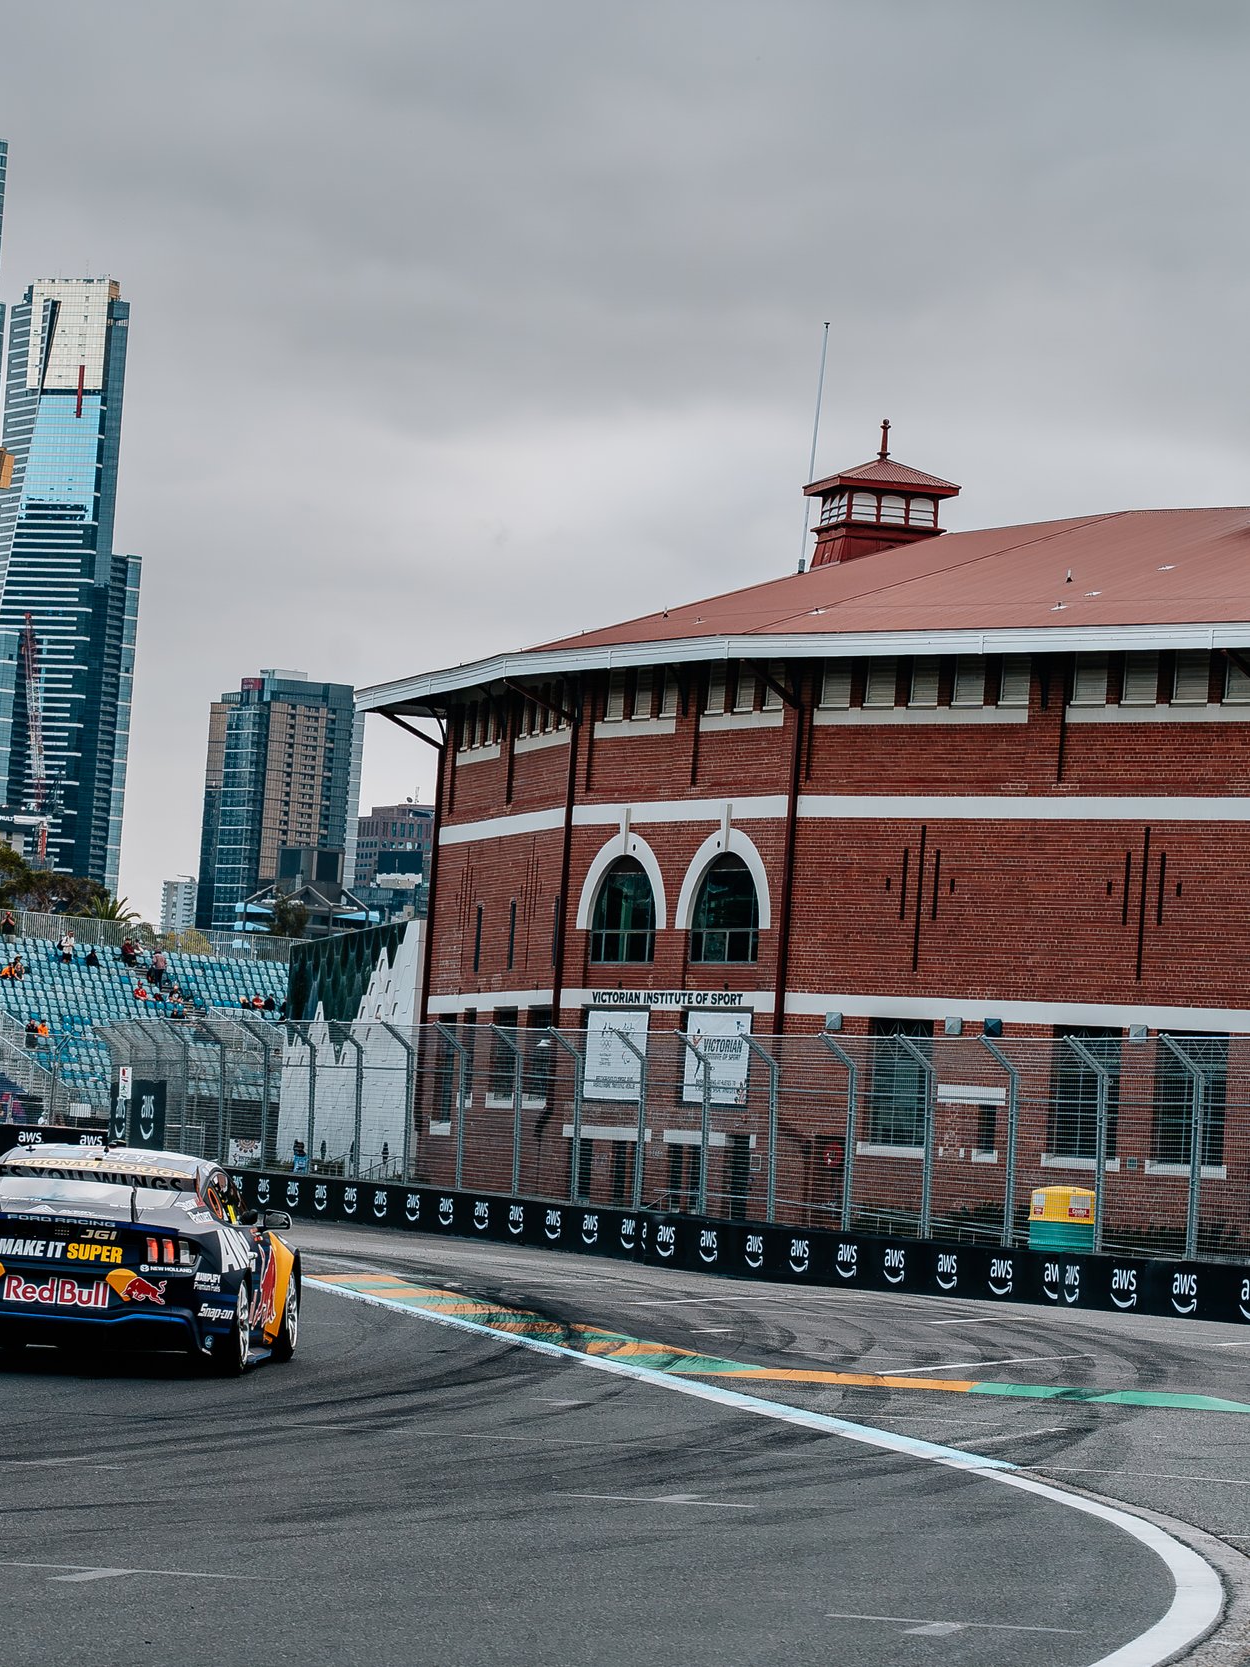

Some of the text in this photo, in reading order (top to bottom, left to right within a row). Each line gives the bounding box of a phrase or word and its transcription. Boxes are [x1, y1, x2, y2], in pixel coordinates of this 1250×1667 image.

[592, 991, 743, 1006] VICTORIAN INSTITUTE OF SPORT
[704, 1039, 743, 1053] VICTORIAN
[18, 1131, 42, 1144] aws
[79, 1134, 103, 1146] aws
[30, 1166, 85, 1181] YOU
[92, 1171, 184, 1192] WINGS
[258, 1179, 270, 1193] aws
[287, 1182, 299, 1196] aws
[315, 1185, 327, 1199] aws
[345, 1187, 357, 1202] aws
[374, 1191, 387, 1206] aws
[406, 1194, 420, 1210] aws
[440, 1198, 454, 1214] aws
[474, 1201, 489, 1218] aws
[509, 1205, 524, 1222] aws
[7, 1214, 52, 1223] FORD
[54, 1215, 116, 1228] RACING
[546, 1210, 561, 1227] aws
[583, 1214, 599, 1232] aws
[657, 1225, 675, 1243] aws
[700, 1230, 717, 1248] aws
[46, 1241, 66, 1258] IT
[67, 1243, 123, 1264] SUPER
[745, 1235, 763, 1254] aws
[791, 1239, 809, 1258] aws
[838, 1244, 857, 1264] aws
[885, 1248, 905, 1269] aws
[937, 1253, 957, 1273] aws
[990, 1259, 1012, 1280] aws
[1064, 1264, 1080, 1286] aws
[1112, 1268, 1137, 1291] aws
[210, 1283, 221, 1293] Fuels
[1173, 1272, 1197, 1296] aws
[197, 1302, 235, 1321] Snap-on
